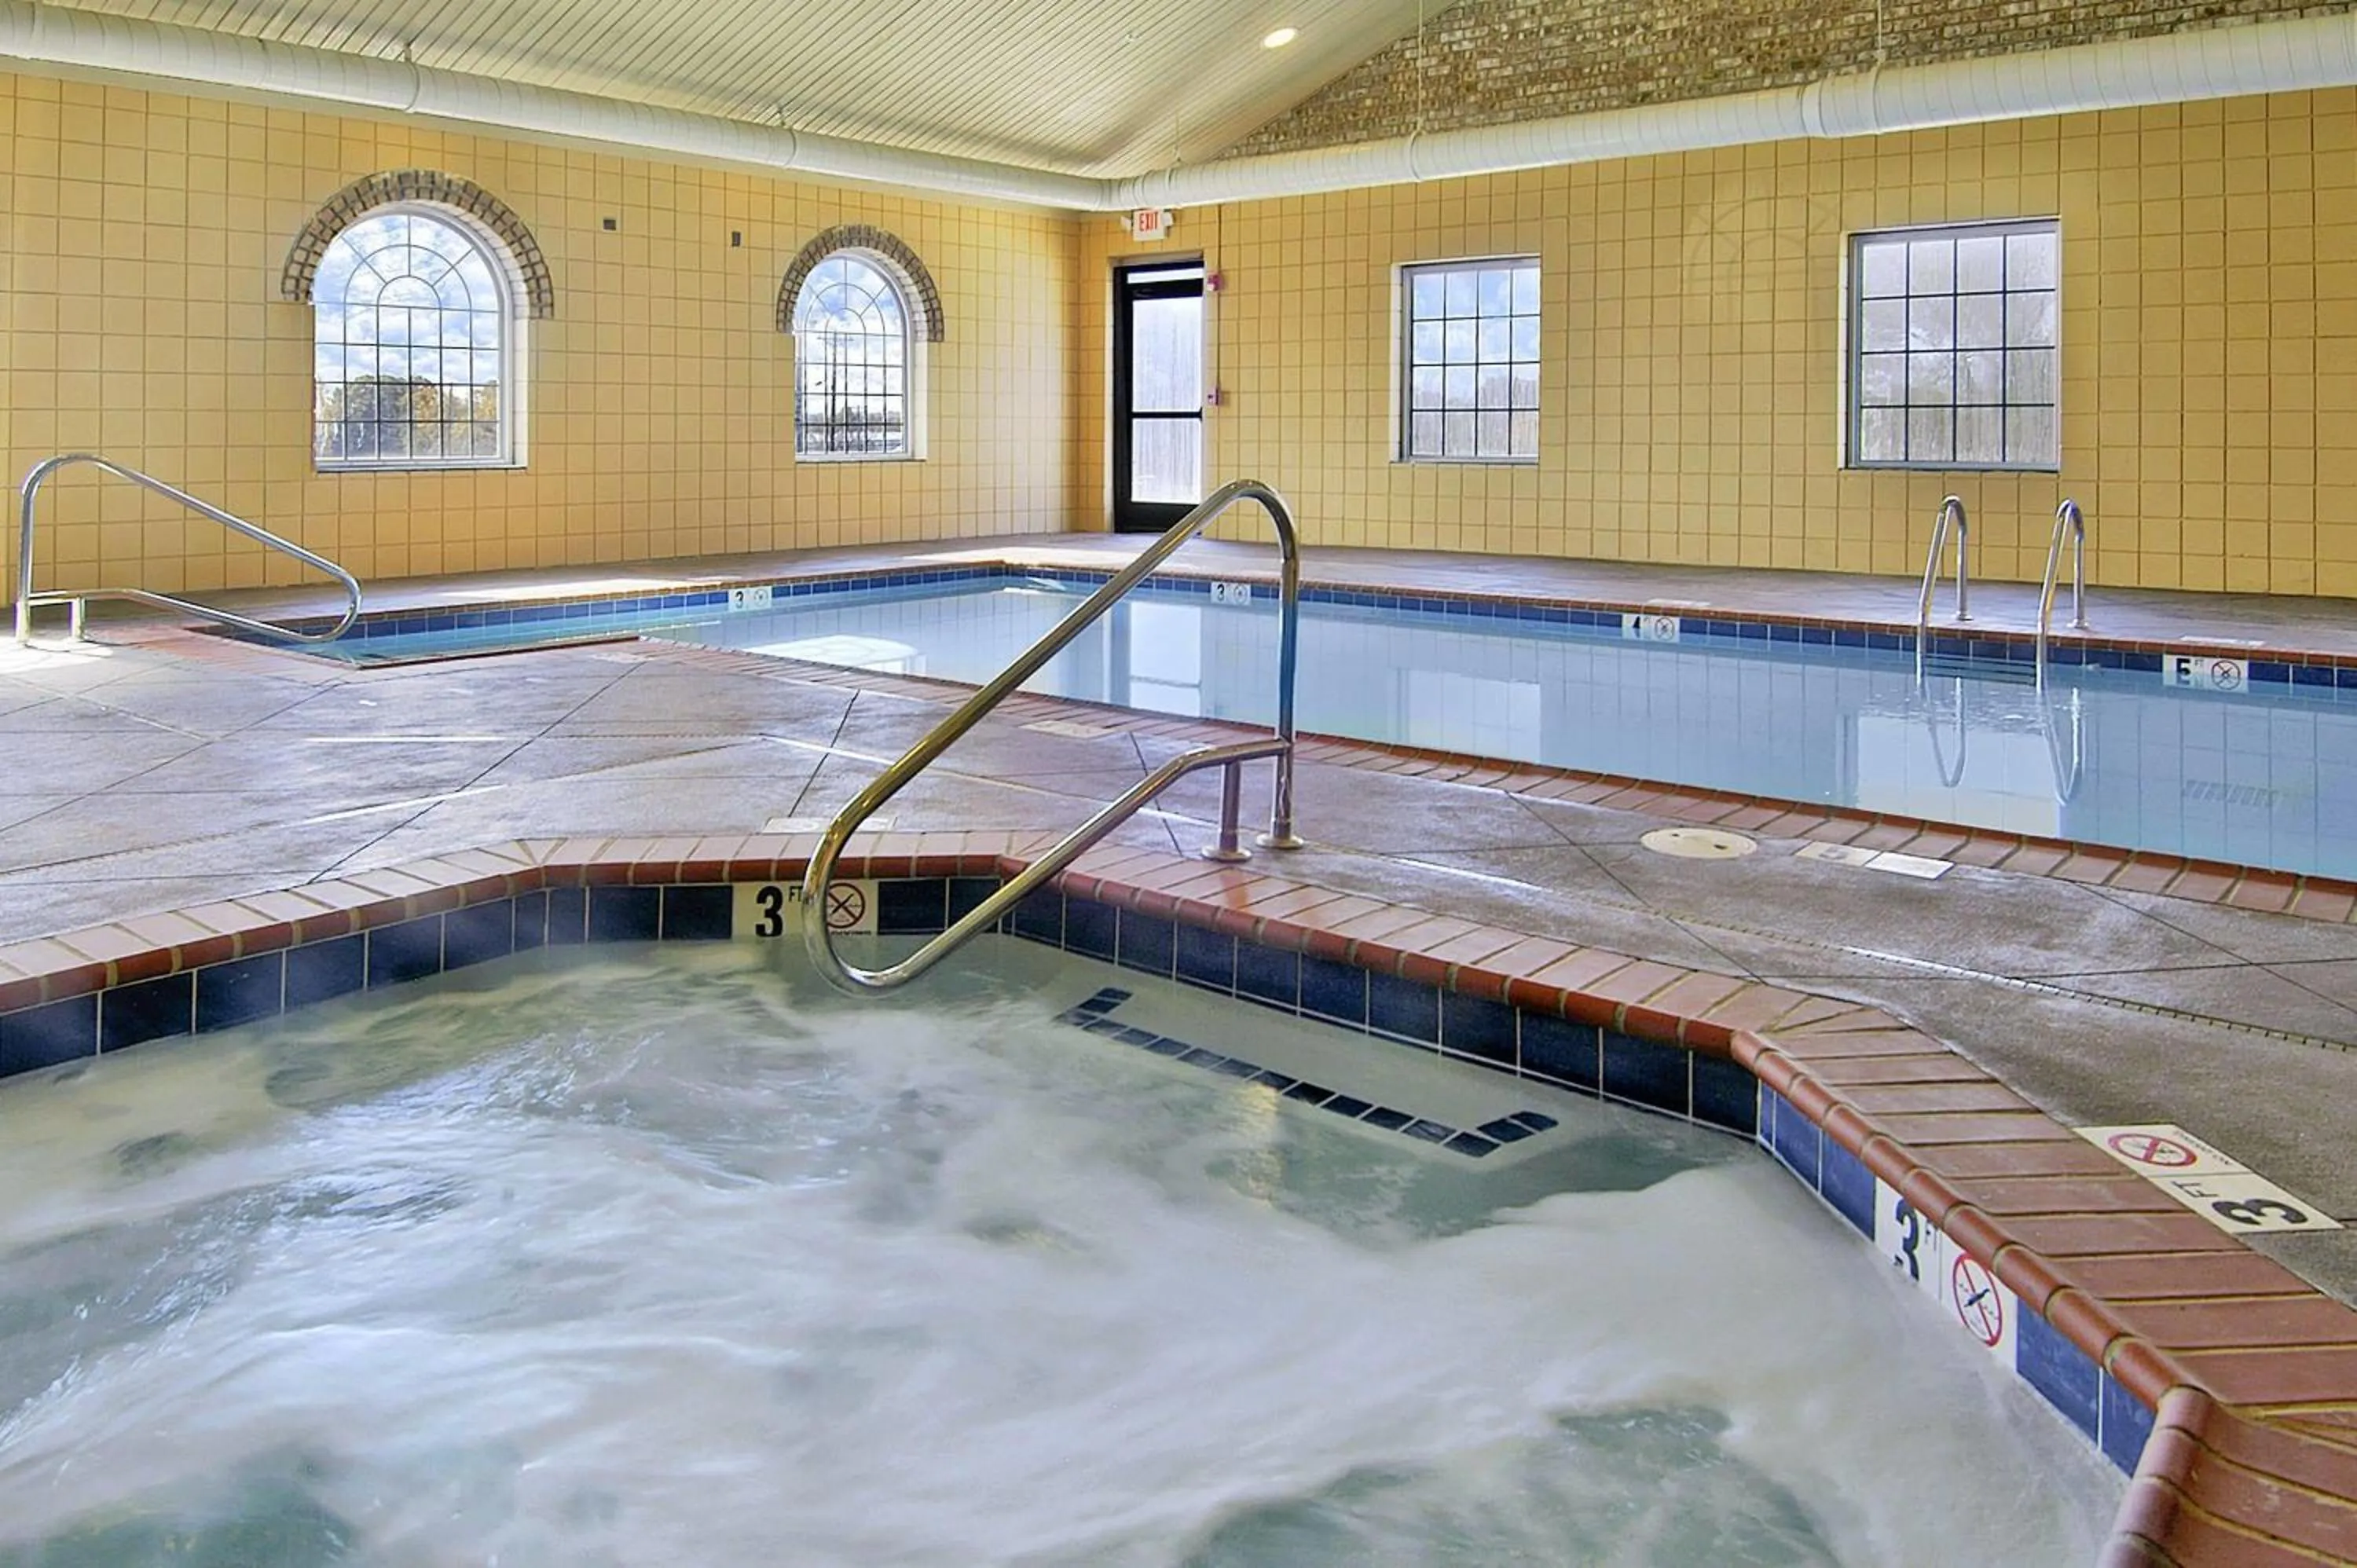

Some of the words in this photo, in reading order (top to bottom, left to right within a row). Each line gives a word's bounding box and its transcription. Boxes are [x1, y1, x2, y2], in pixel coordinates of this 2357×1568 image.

[1139, 211, 1159, 232] EXIT
[755, 885, 784, 937] 3
[2211, 1198, 2309, 1225] 3
[1893, 1197, 1919, 1282] 3
